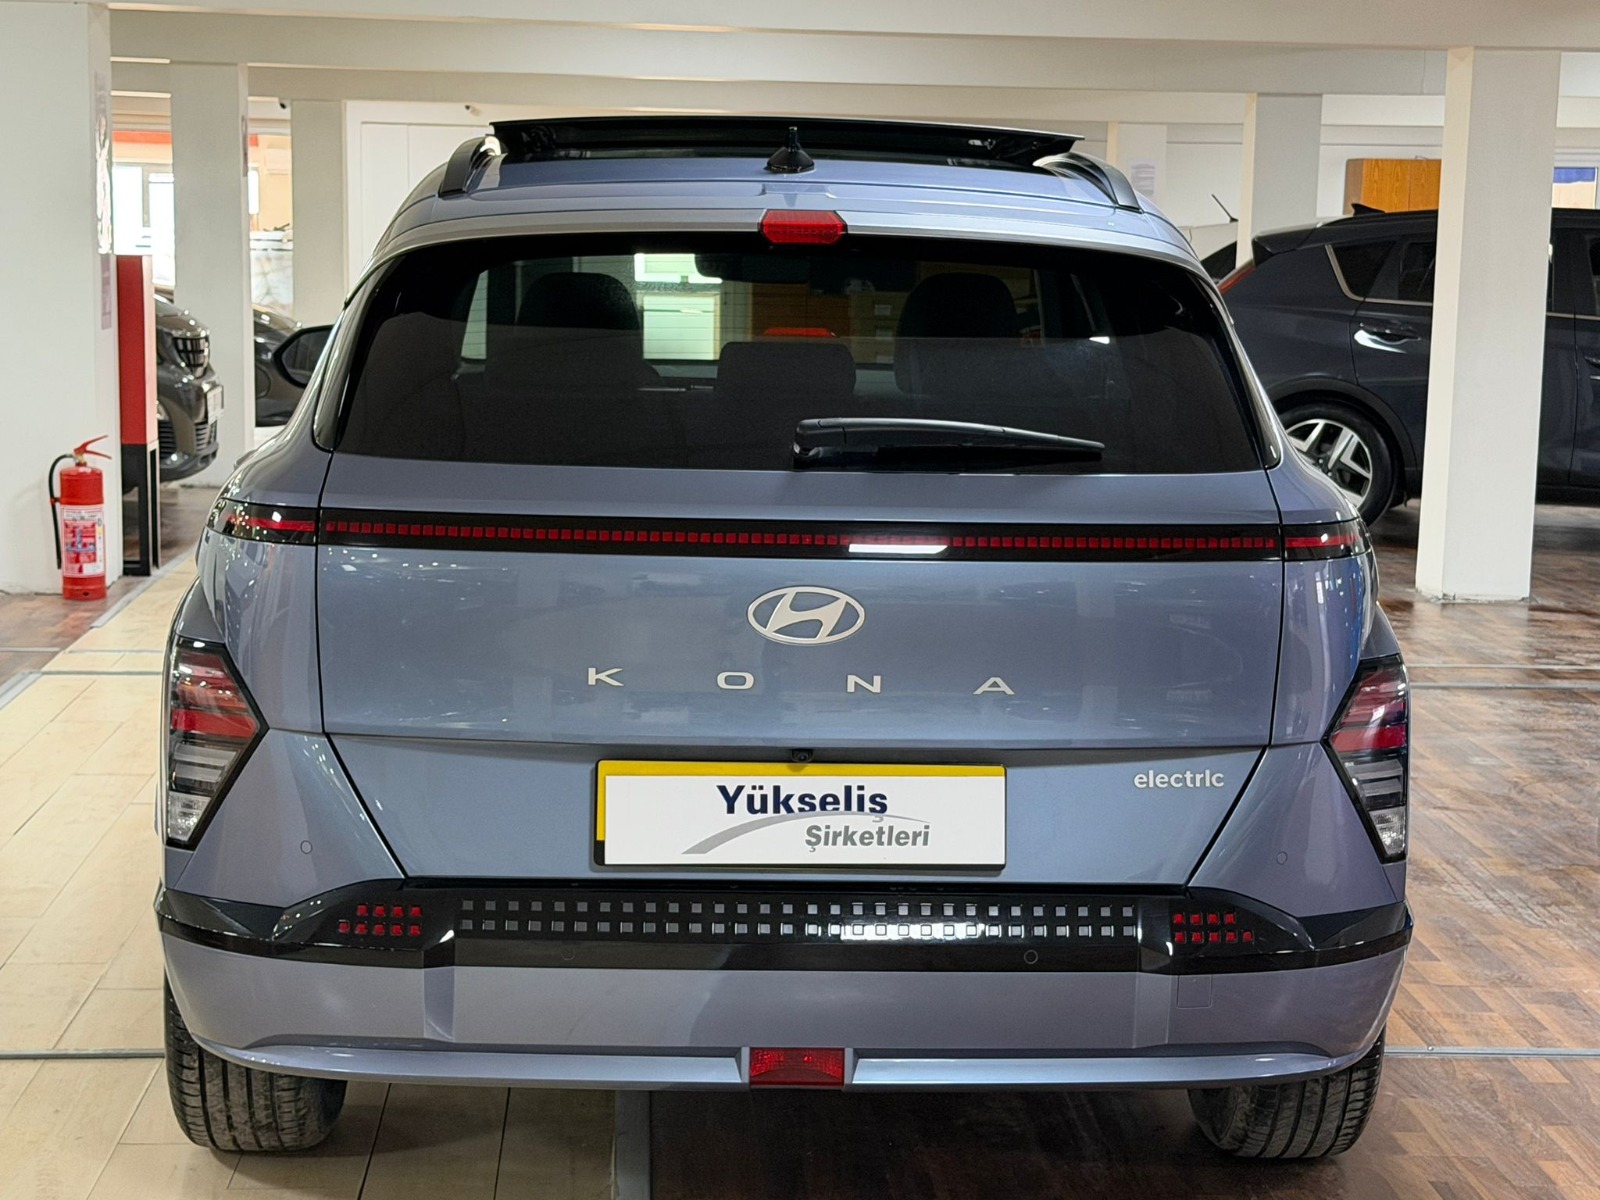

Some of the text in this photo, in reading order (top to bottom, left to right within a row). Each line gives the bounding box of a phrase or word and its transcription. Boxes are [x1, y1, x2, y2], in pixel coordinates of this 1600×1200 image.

[587, 666, 1015, 696] KONA
[716, 784, 888, 823] Yükseliş
[805, 824, 931, 853] Şirketleri
